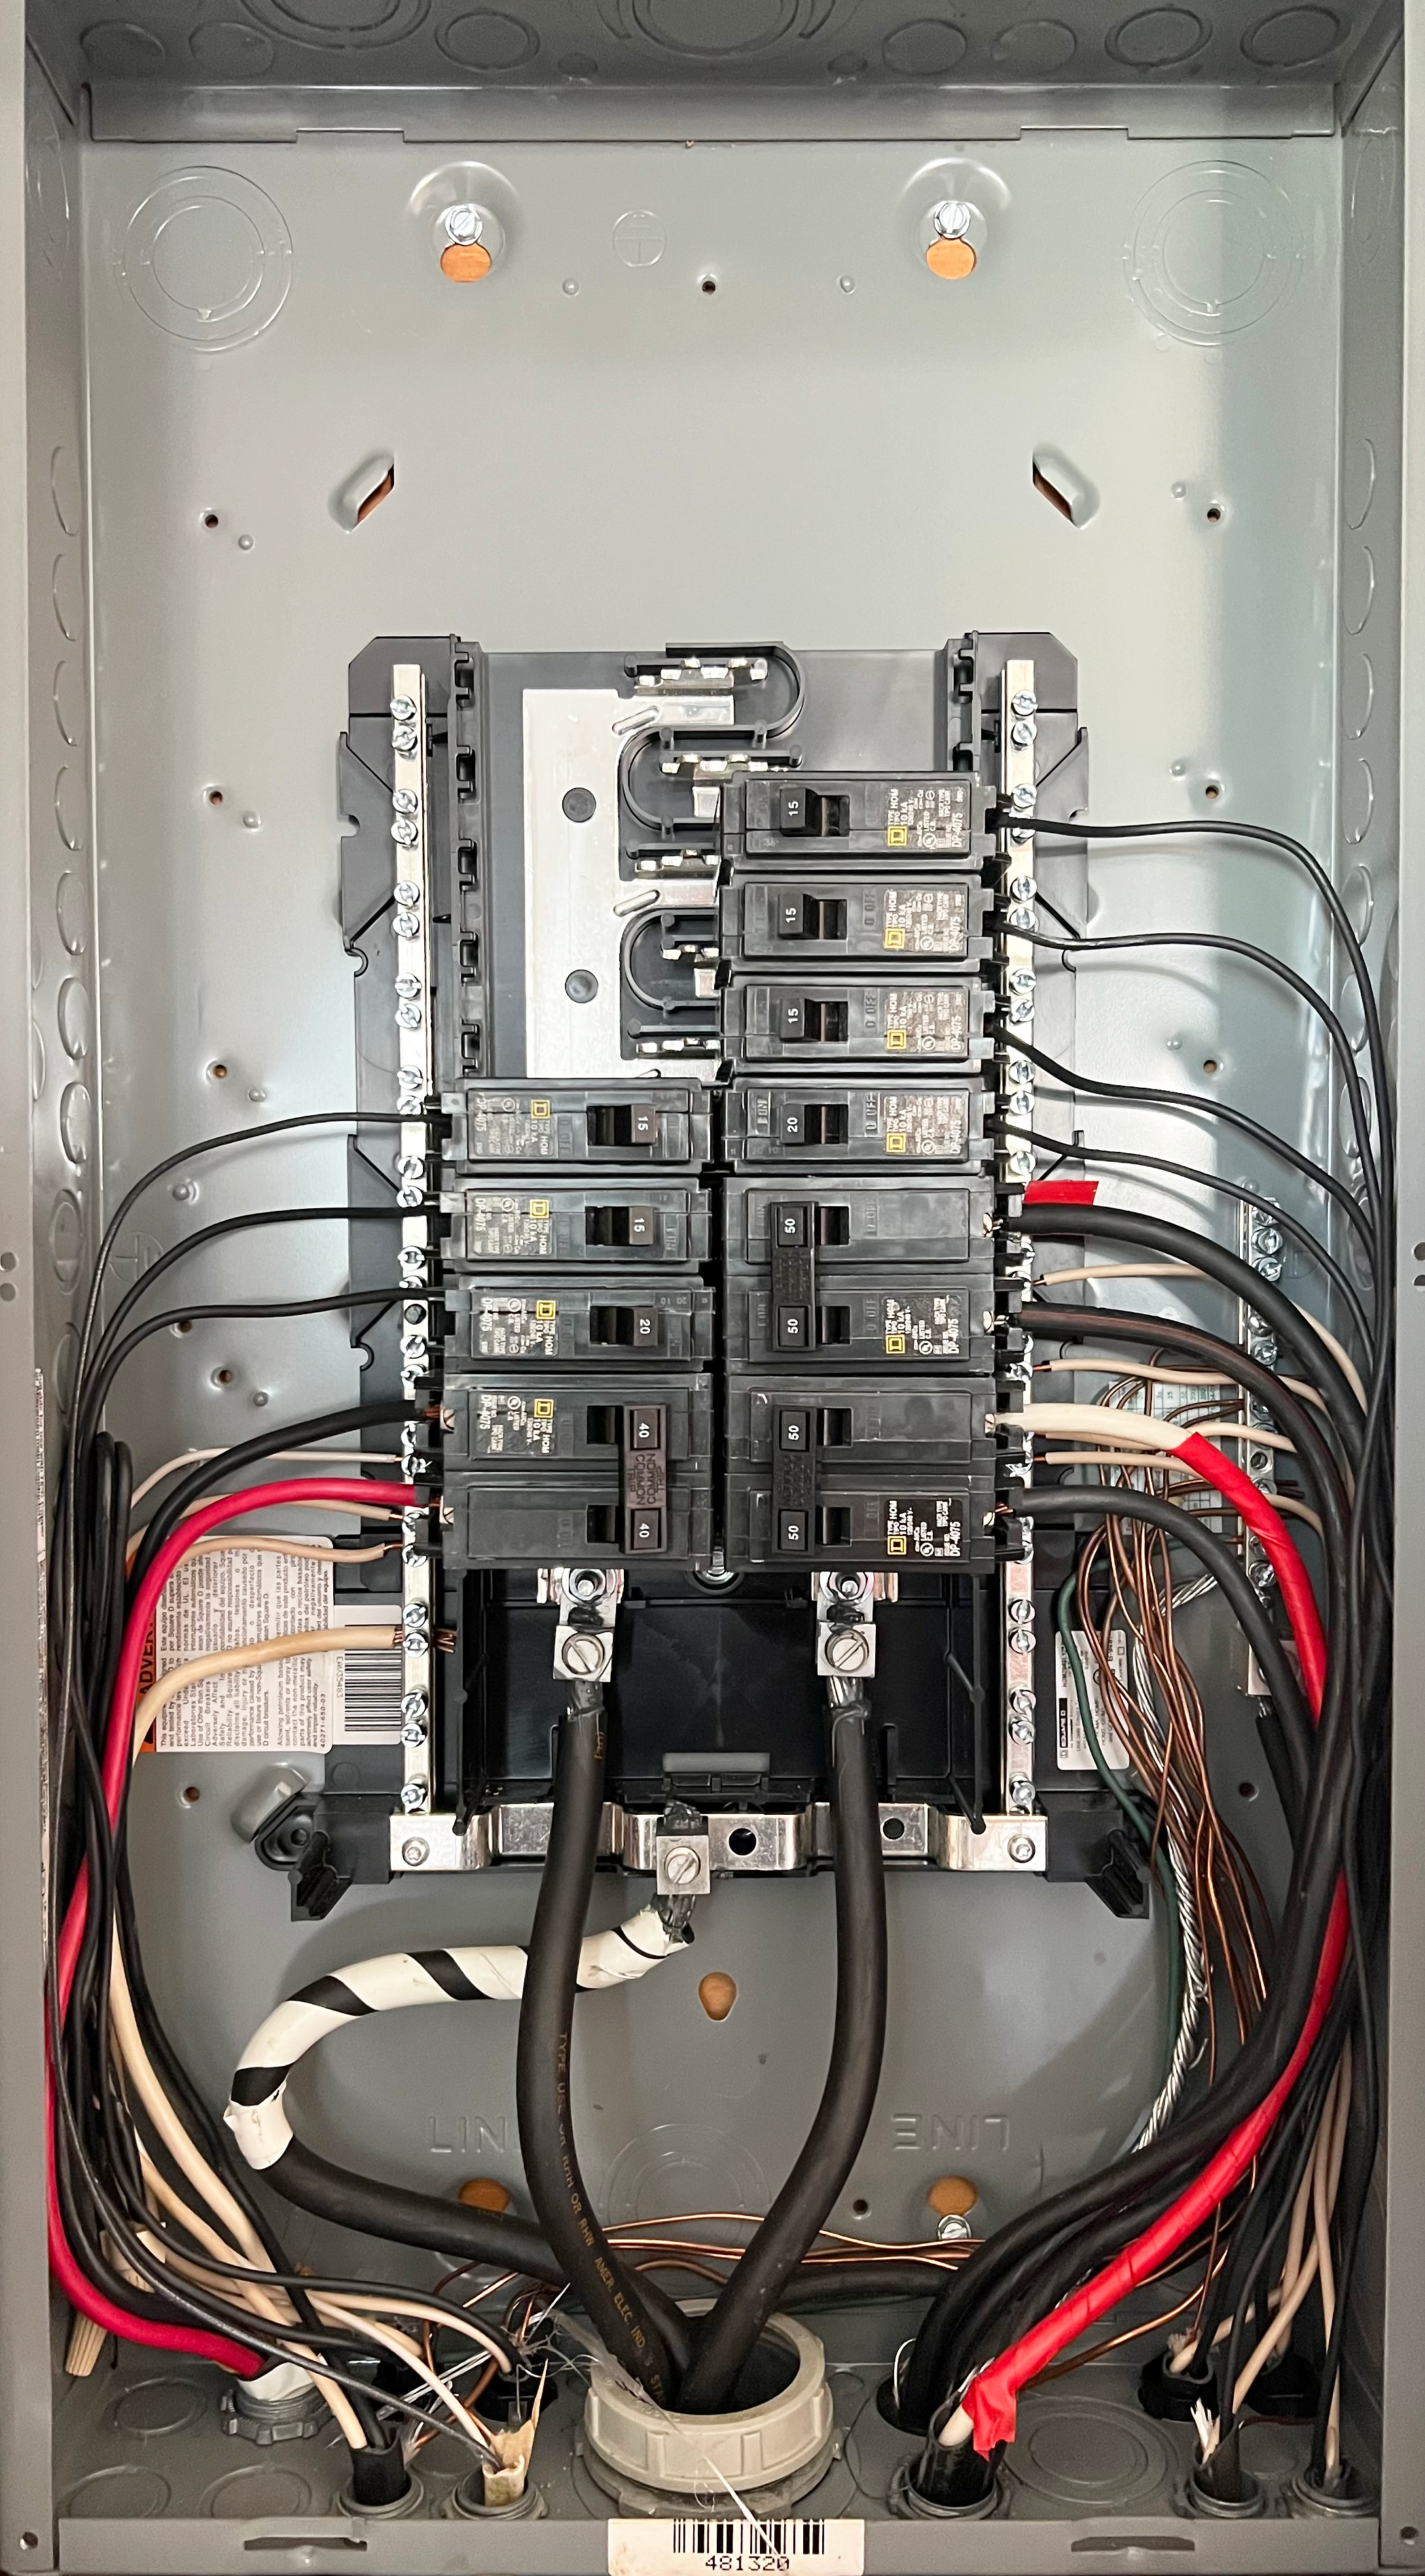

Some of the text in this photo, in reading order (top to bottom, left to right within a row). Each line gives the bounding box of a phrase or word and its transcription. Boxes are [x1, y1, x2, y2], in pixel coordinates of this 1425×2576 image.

[788, 800, 799, 815] 15
[901, 802, 908, 825] 10 kA
[952, 813, 963, 847] DP-4075
[785, 908, 796, 923] 15
[899, 904, 905, 927] 10 kA
[950, 916, 960, 951] DP-4075
[788, 1008, 798, 1024] 15
[900, 1006, 907, 1028] 10 kA
[951, 1016, 962, 1050] DP-4075
[532, 1120, 538, 1142] 10 kA
[638, 1117, 648, 1130] 15
[787, 1117, 797, 1132] 20
[899, 1109, 906, 1132] 10 kA
[950, 1120, 961, 1153] DP-4075
[475, 1198, 486, 1230] DP-4075
[634, 1218, 644, 1232] 15
[530, 1220, 537, 1242] 10 kA
[785, 1219, 795, 1234] 50
[481, 1298, 492, 1331] DP-4075
[897, 1312, 905, 1334] 10 kA
[536, 1321, 543, 1342] 10 kA
[640, 1319, 650, 1334] 20
[788, 1319, 799, 1334] 50
[948, 1319, 959, 1353] DP-4075
[480, 1395, 491, 1429] DP-4075
[533, 1418, 541, 1440] 10 kA
[639, 1423, 649, 1438] 40
[788, 1425, 799, 1440] 50
[636, 1454, 645, 1505] COMMON
[647, 1454, 656, 1504] COMMON
[639, 1524, 649, 1538] 40
[788, 1526, 799, 1541] 50
[899, 1512, 907, 1535] 10 kA
[950, 1522, 960, 1556] DP-4075
[429, 2116, 508, 2153] LIN
[558, 2032, 568, 2073] TYPE
[571, 2192, 582, 2215] OR
[577, 2218, 594, 2247] RHW
[890, 2114, 1009, 2152] LINE
[705, 2556, 789, 2571] 481320
